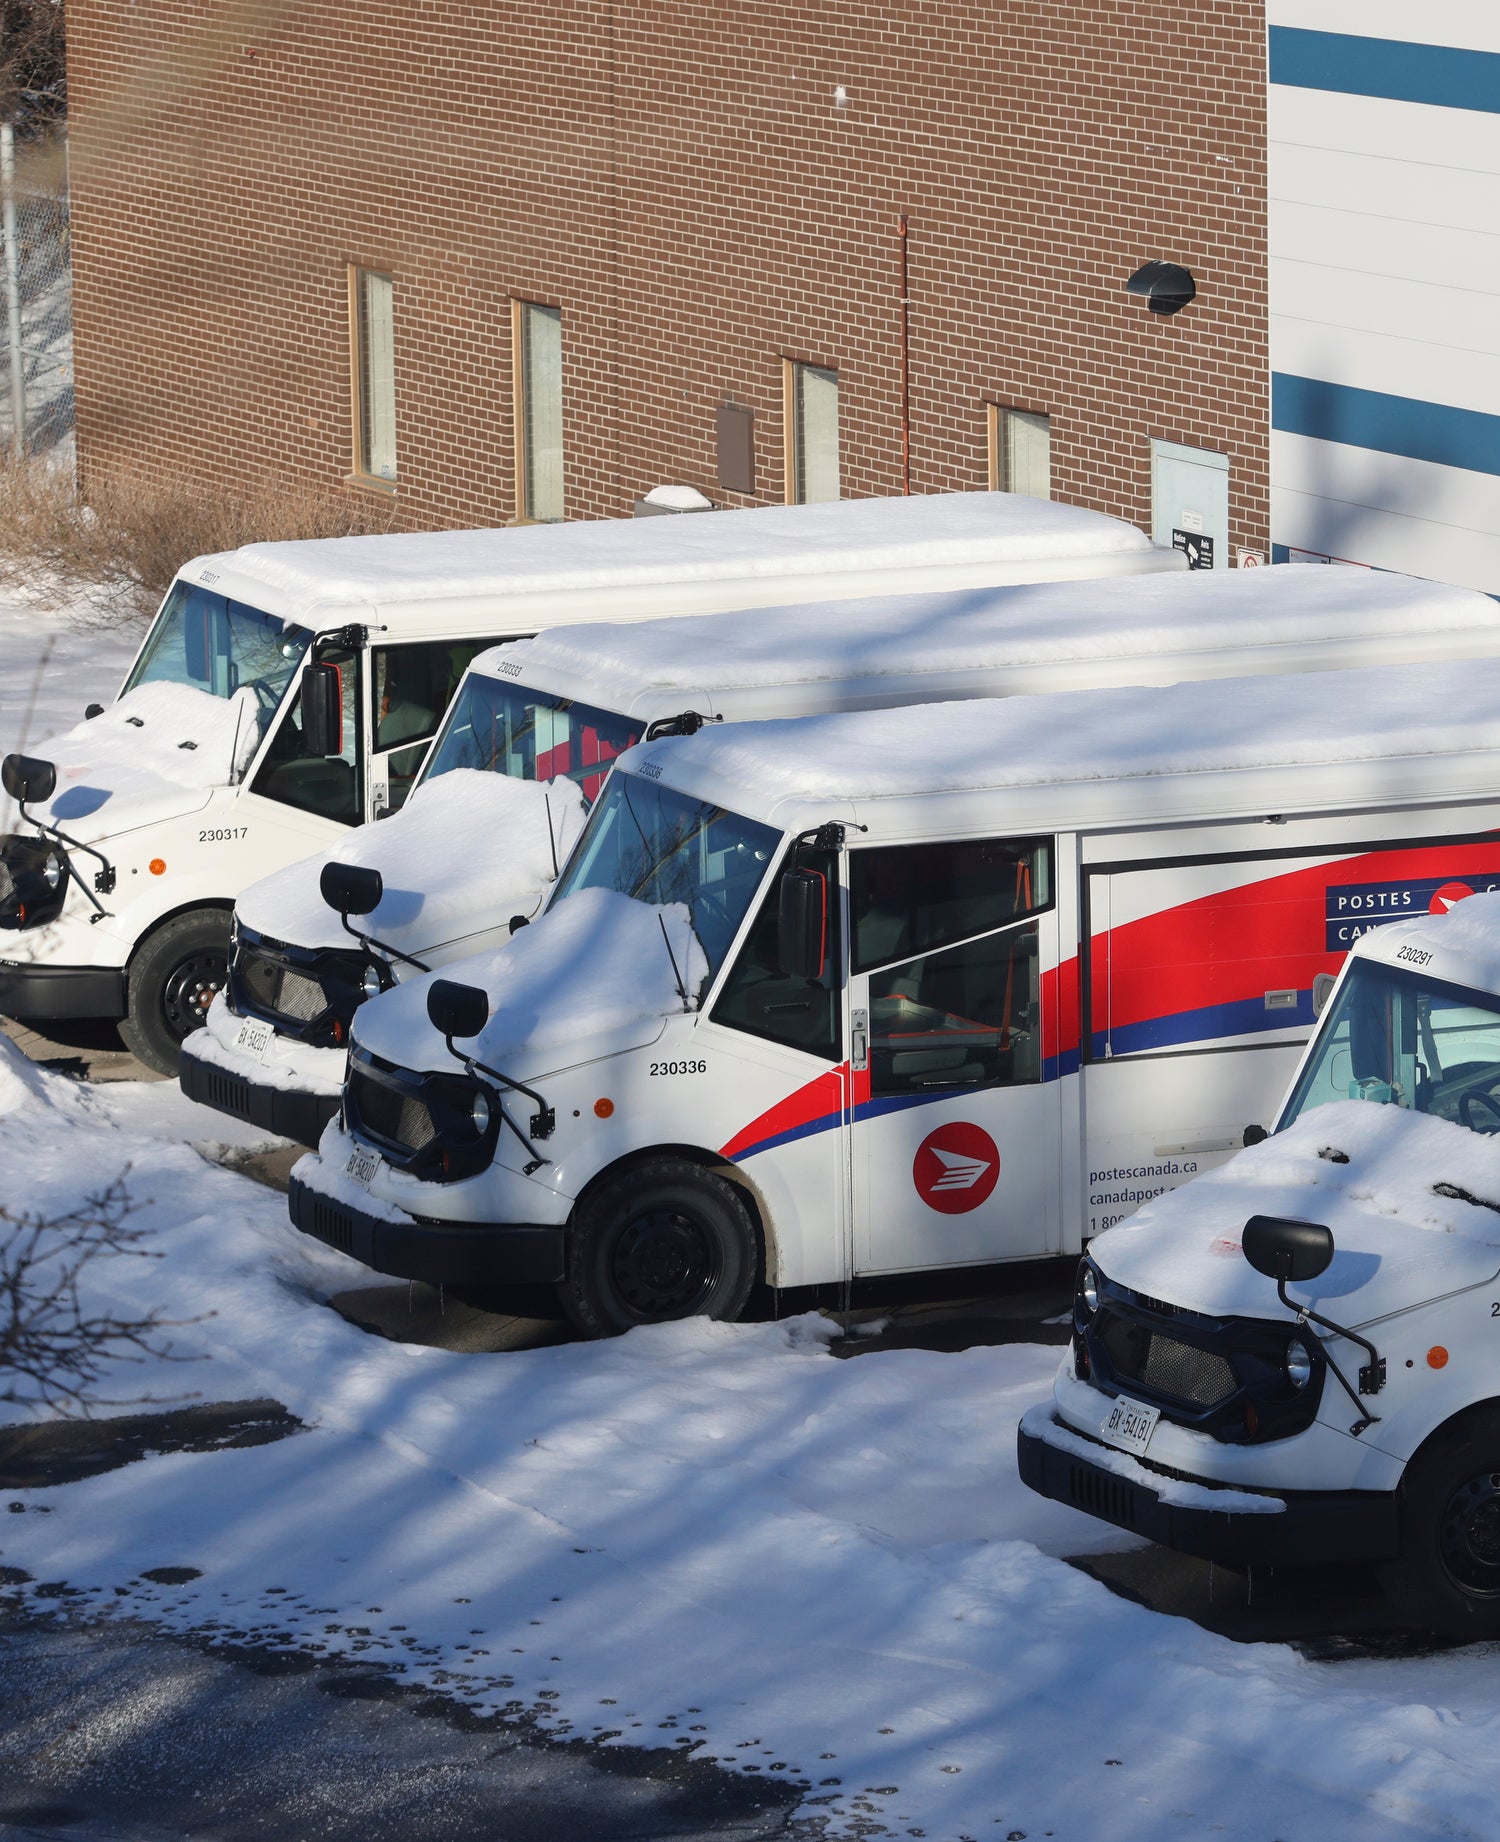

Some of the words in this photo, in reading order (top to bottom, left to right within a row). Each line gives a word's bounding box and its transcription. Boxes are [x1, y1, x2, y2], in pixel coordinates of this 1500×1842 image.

[199, 827, 248, 842] 230317
[1338, 891, 1411, 910] POSTES
[1397, 945, 1433, 966] 230291
[650, 1060, 707, 1076] 230336
[1089, 1161, 1198, 1186] postescanada.ca
[1090, 1217, 1096, 1231] 1
[1108, 1407, 1123, 1430] BX
[1123, 1413, 1152, 1441] 54181
